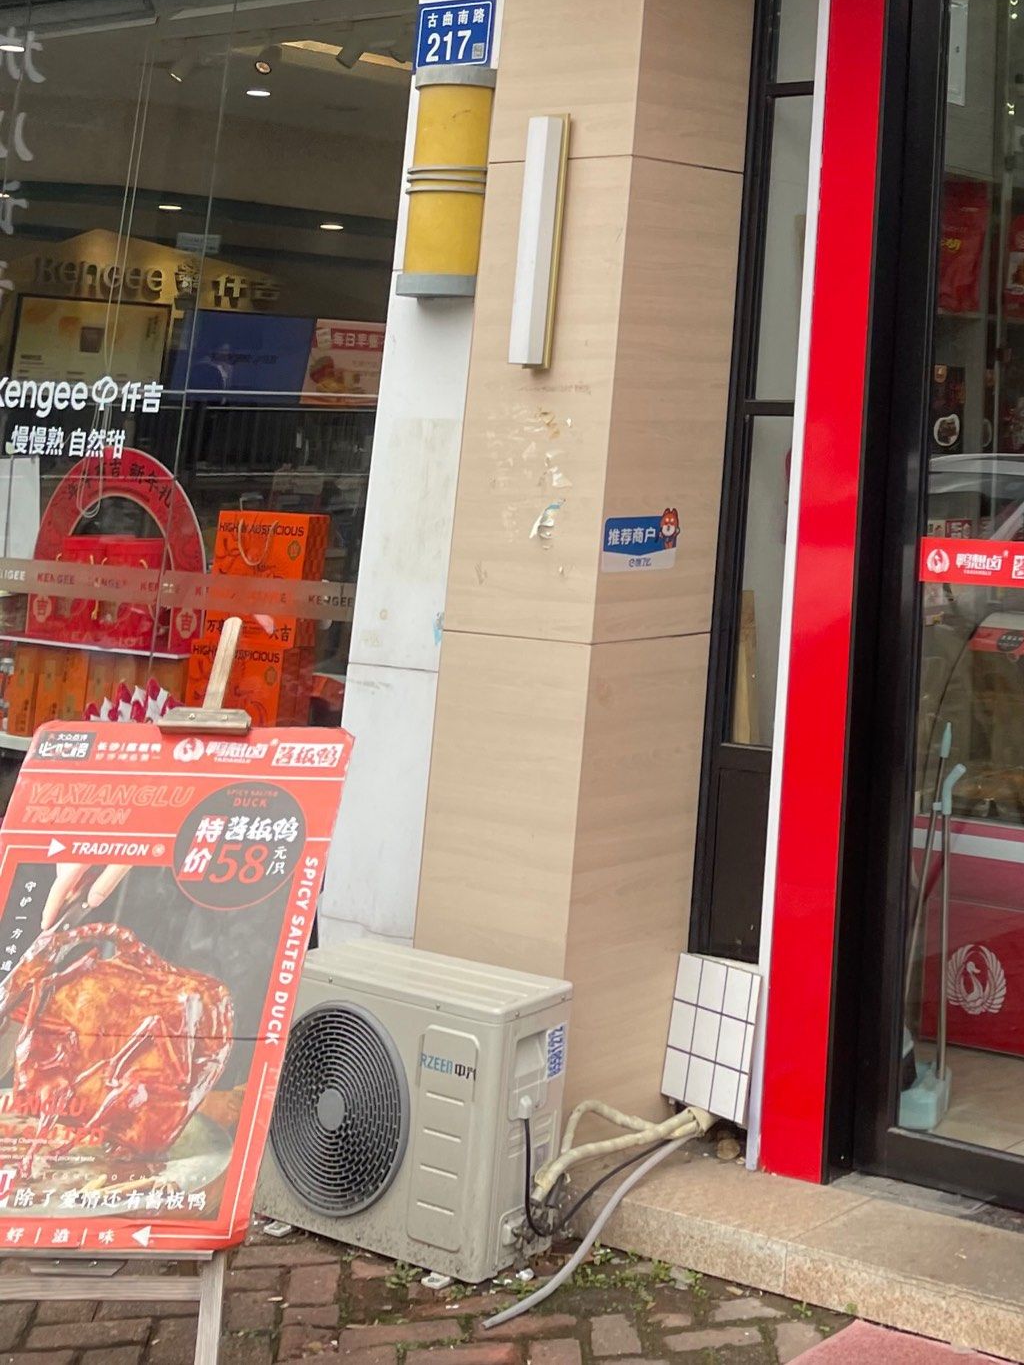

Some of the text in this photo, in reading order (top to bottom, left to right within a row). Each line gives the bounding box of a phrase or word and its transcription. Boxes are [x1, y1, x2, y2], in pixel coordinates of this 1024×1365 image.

[427, 7, 486, 29] 古曲南路
[425, 29, 472, 63] 217
[120, 381, 164, 415] 仟吉
[11, 424, 127, 459] 慢慢熟 自然甜
[607, 526, 656, 547] 推荐商户
[955, 552, 1003, 572] 鸭想卤
[180, 610, 196, 632] 吉
[234, 649, 281, 664] USPICIOUS
[30, 782, 196, 809] YAXIANGLU
[232, 798, 269, 808] DUCK
[21, 806, 132, 825] TRADITION
[224, 815, 300, 843] 酱板鸭
[70, 841, 150, 857] TRADITION
[182, 816, 226, 874] 特价
[207, 843, 270, 885] 58
[264, 856, 319, 1047] SPICY SALTED DUCK
[13, 1188, 207, 1212] 除了爱情还有酱板鸭
